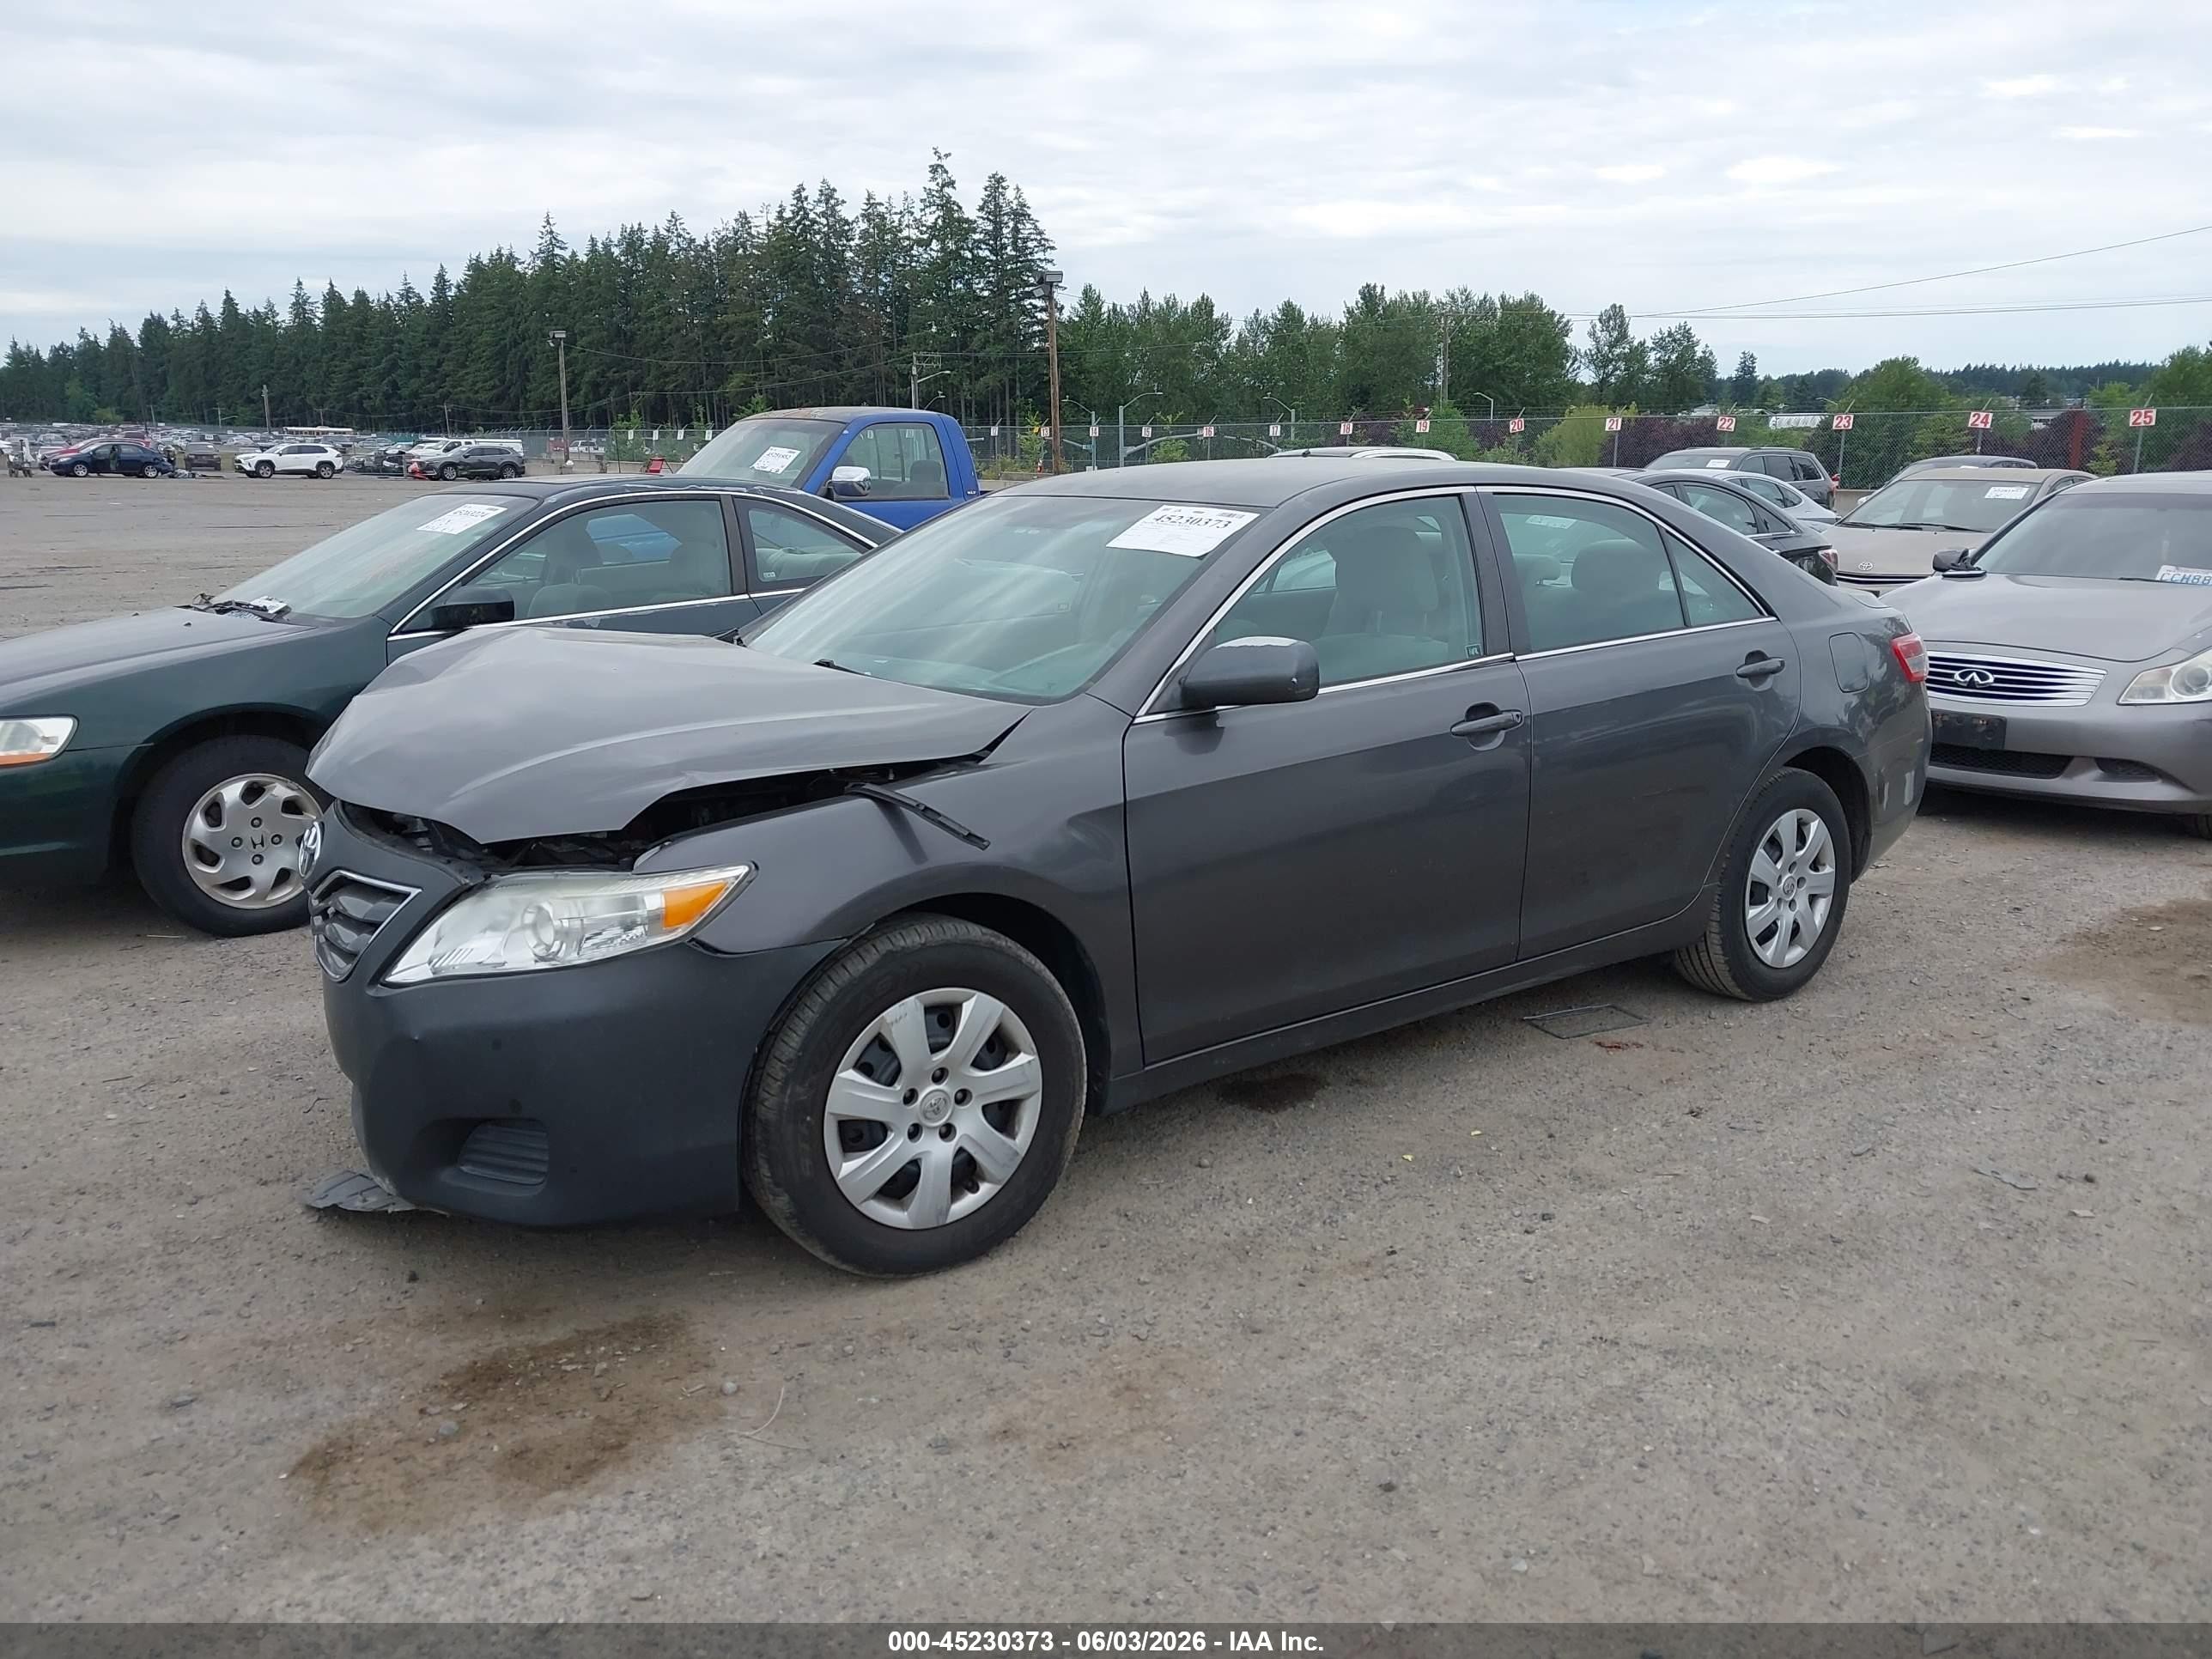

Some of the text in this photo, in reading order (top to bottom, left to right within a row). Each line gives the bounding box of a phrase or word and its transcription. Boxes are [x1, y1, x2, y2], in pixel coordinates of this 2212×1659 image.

[1718, 417, 1734, 430] 22
[1835, 415, 1852, 428] 23
[1971, 413, 1990, 428] 24
[2132, 410, 2154, 426] 25
[1343, 423, 1352, 433] 18
[1419, 421, 1428, 432] 19
[1511, 419, 1523, 432] 20
[1608, 418, 1620, 430] 21
[1042, 427, 1049, 436] 13
[1091, 427, 1098, 436] 14
[1143, 427, 1151, 437] 15
[1205, 427, 1212, 436] 16
[1271, 425, 1279, 435] 17
[1154, 514, 1232, 529] 45230373
